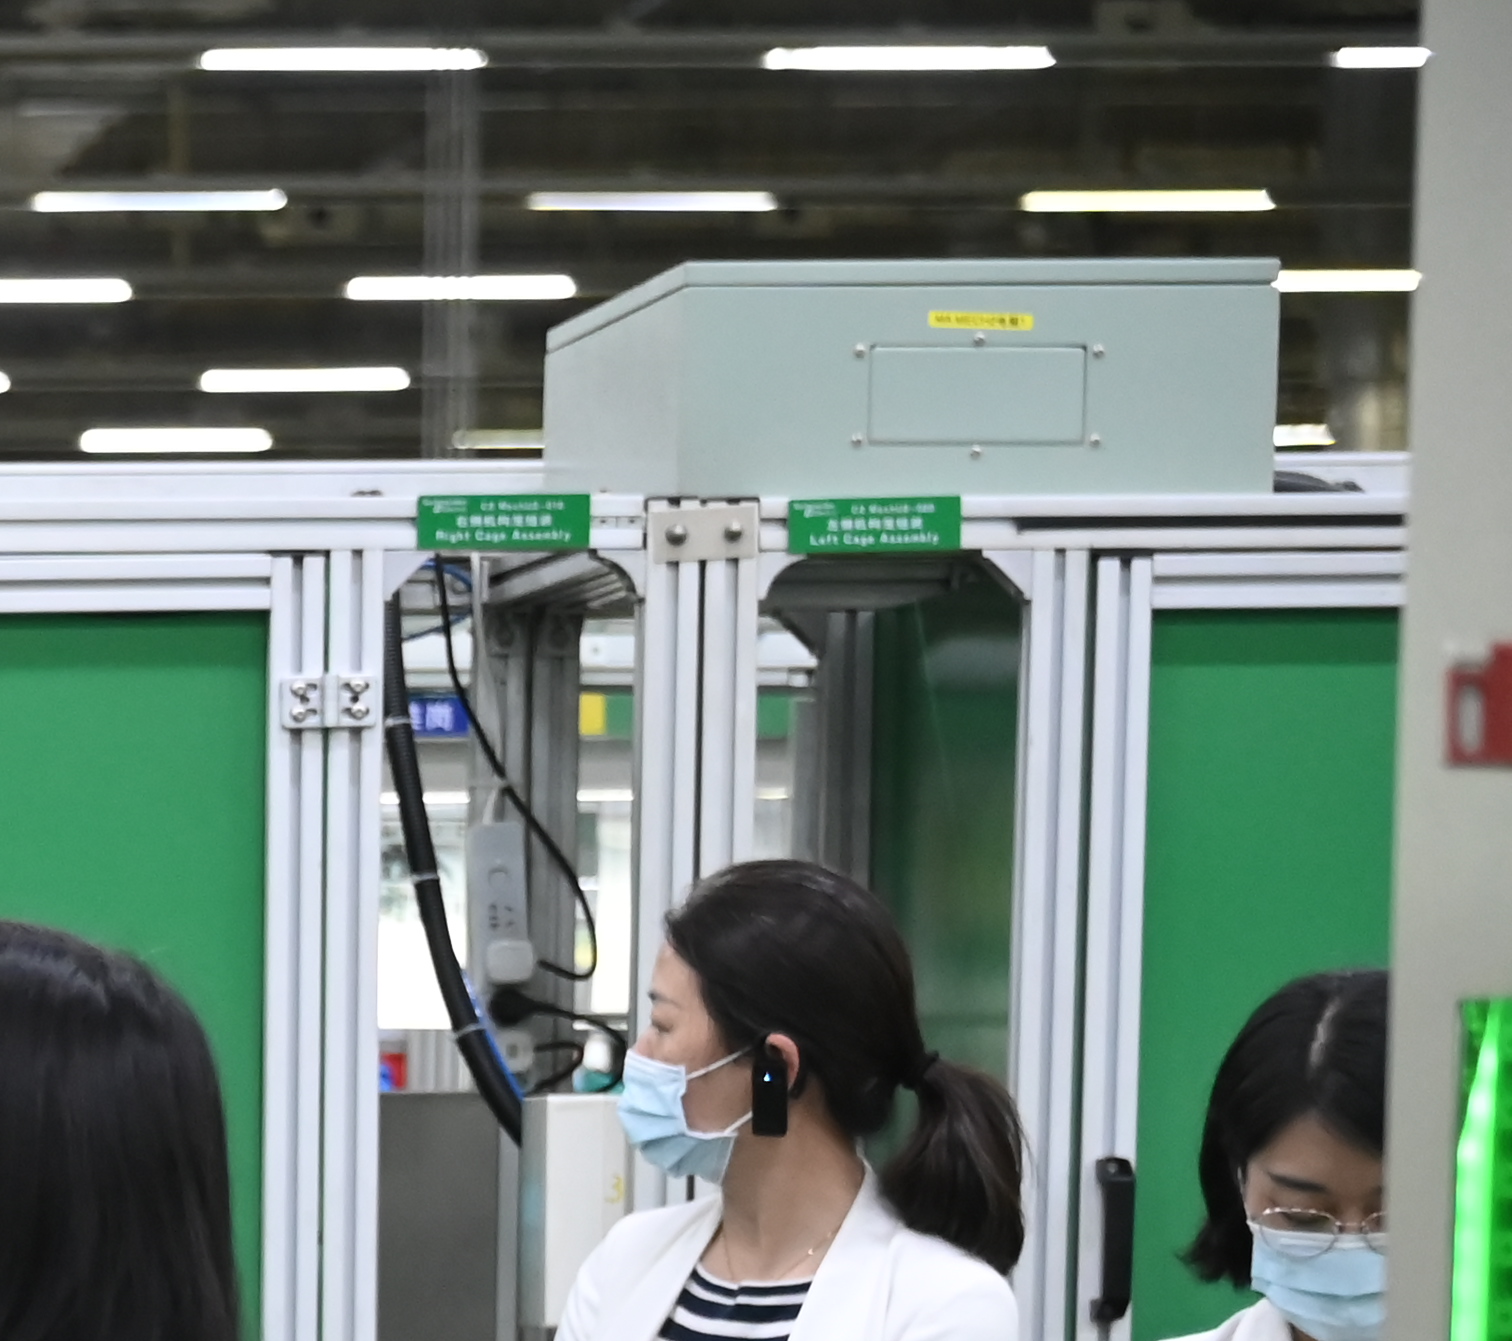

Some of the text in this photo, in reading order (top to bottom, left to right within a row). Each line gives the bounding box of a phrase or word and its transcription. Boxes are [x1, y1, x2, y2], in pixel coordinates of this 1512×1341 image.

[435, 529, 572, 544] Right Cage Assembly
[809, 531, 940, 547] Left Cage Assembly
